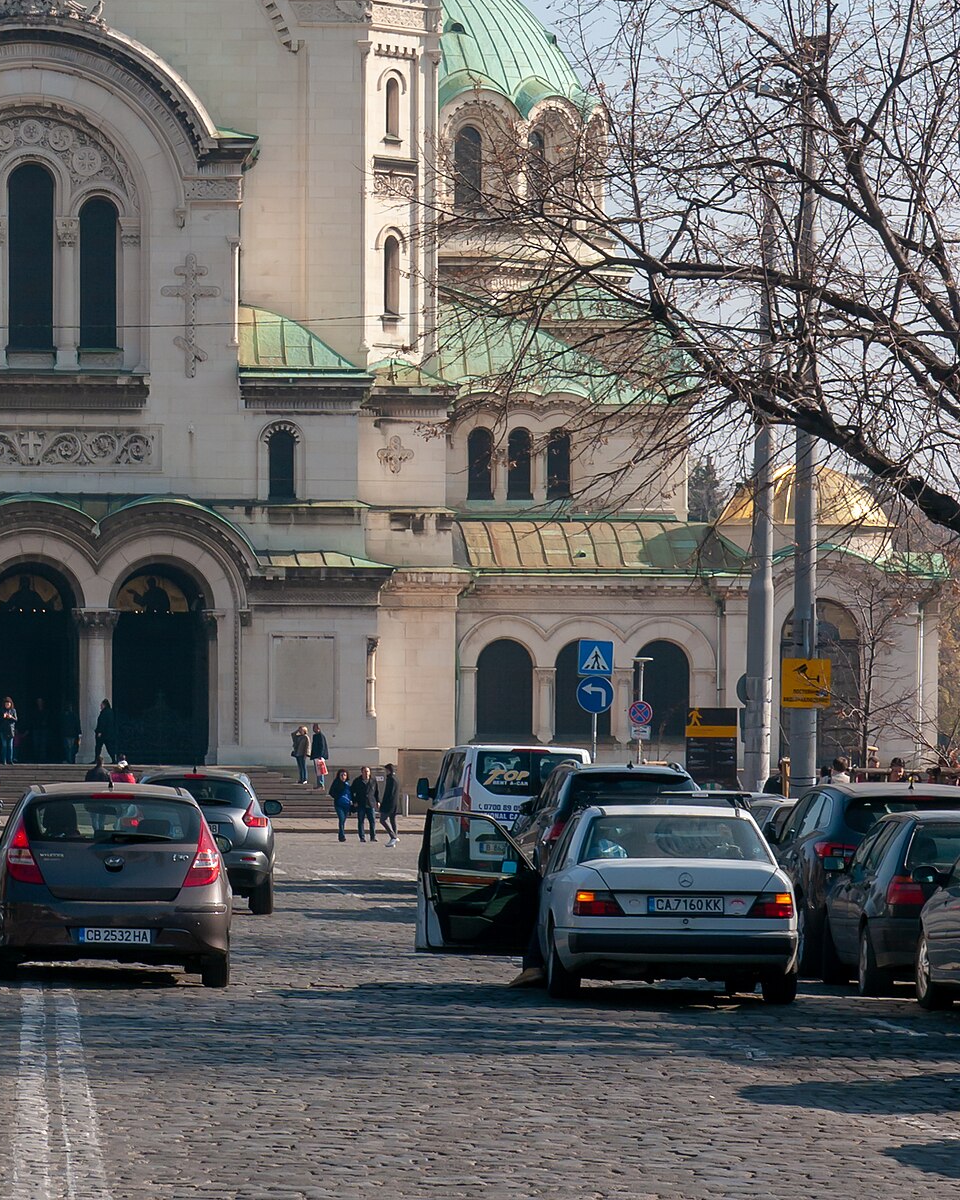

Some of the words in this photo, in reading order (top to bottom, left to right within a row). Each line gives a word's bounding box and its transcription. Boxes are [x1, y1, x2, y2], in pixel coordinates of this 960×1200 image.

[483, 769, 530, 785] TOP
[656, 899, 672, 911] CA
[674, 899, 704, 911] 7160
[705, 899, 722, 911] KK
[86, 929, 101, 941] CB
[103, 929, 132, 942] 2532
[133, 930, 149, 943] HA
